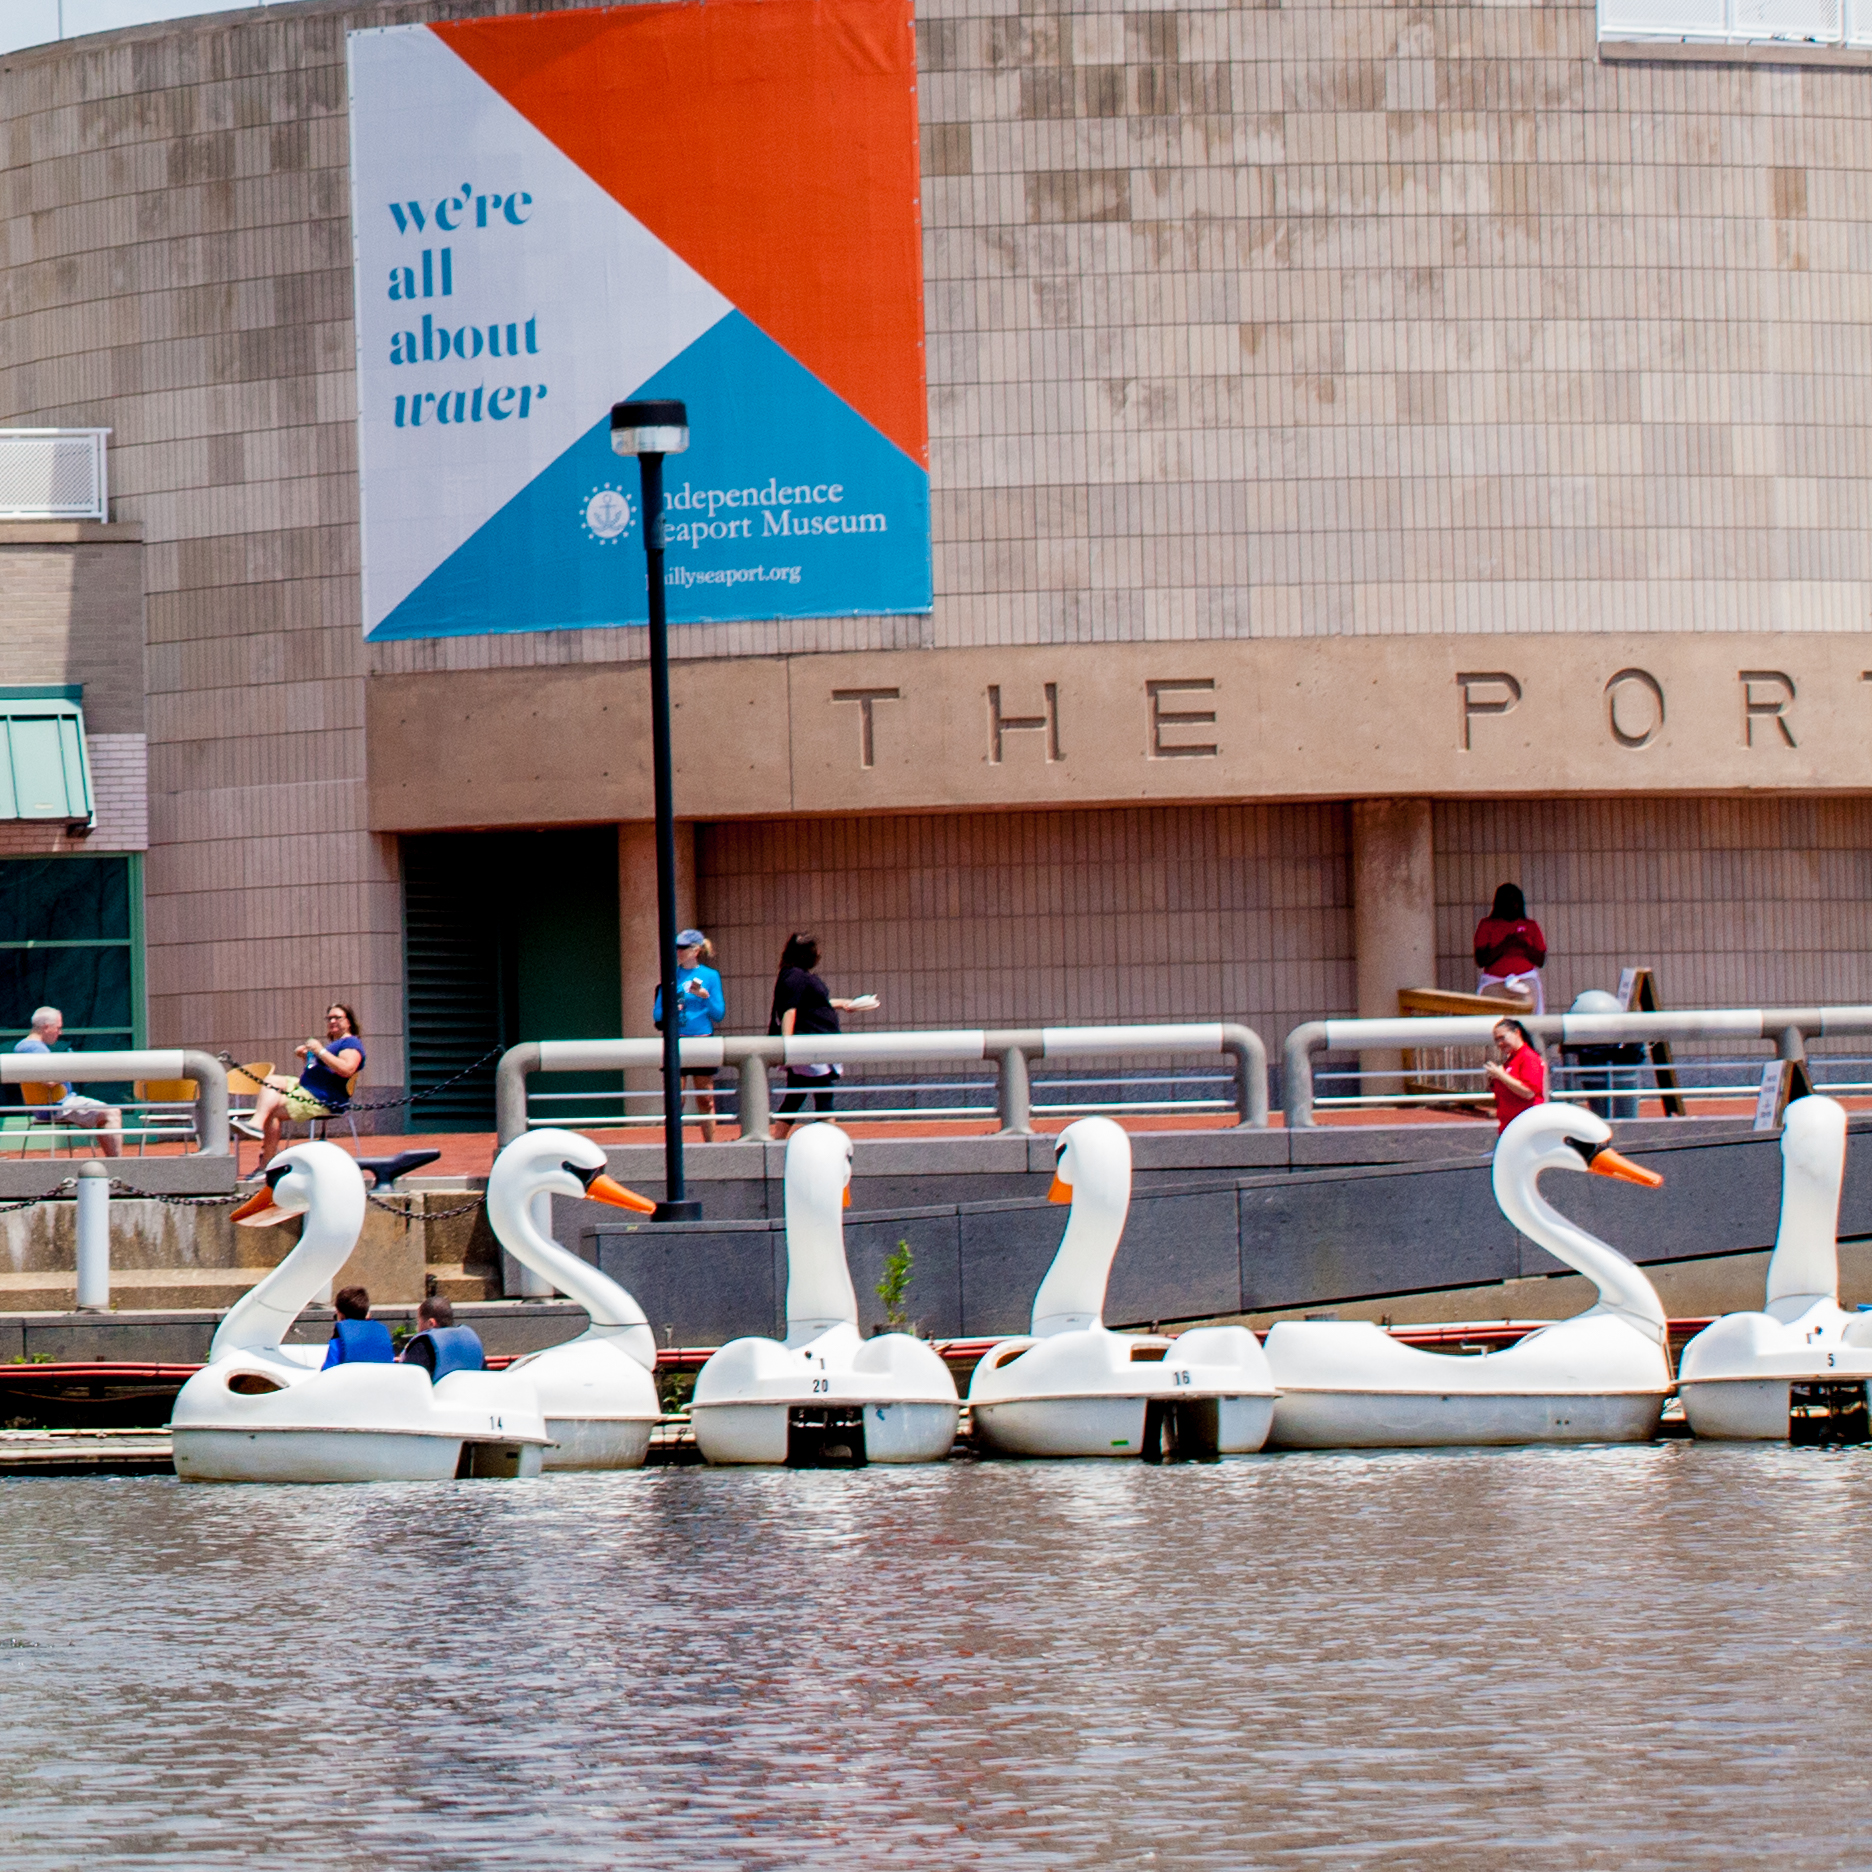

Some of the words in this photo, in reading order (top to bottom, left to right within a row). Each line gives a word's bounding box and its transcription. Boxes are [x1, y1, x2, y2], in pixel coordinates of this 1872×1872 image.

[388, 182, 533, 236] we're
[387, 246, 453, 301] all
[389, 311, 541, 365] about
[393, 378, 548, 429] water
[663, 477, 844, 518] ndependence
[663, 517, 753, 549] eaport
[761, 509, 888, 538] Museum
[831, 677, 1219, 769] THE
[1173, 1370, 1191, 1386] 16
[1827, 1352, 1834, 1367] 5
[812, 1378, 829, 1393] 20
[489, 1415, 503, 1430] 14
